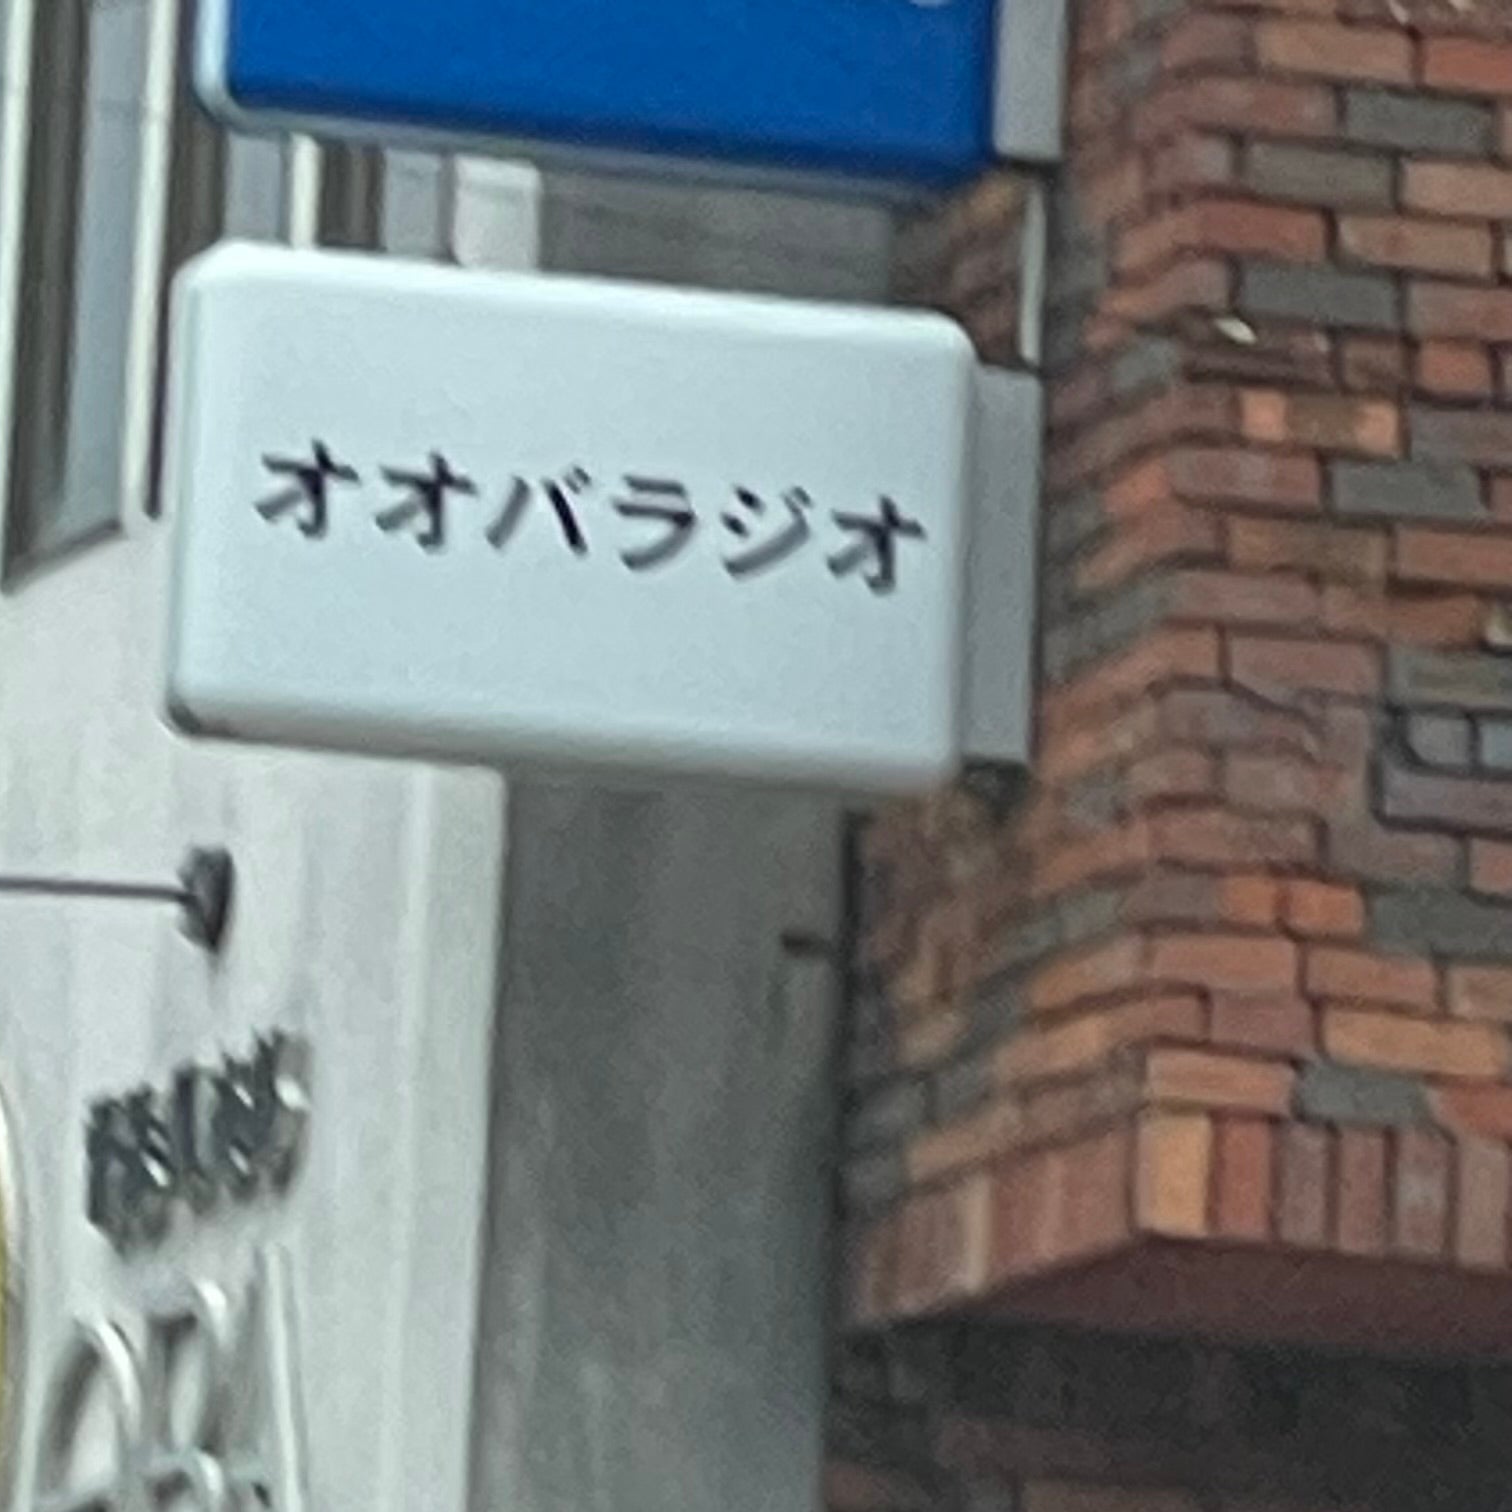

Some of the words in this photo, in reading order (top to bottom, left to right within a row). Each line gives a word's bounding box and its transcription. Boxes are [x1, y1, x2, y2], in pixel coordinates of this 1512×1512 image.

[253, 438, 927, 598] オオバラジオ
